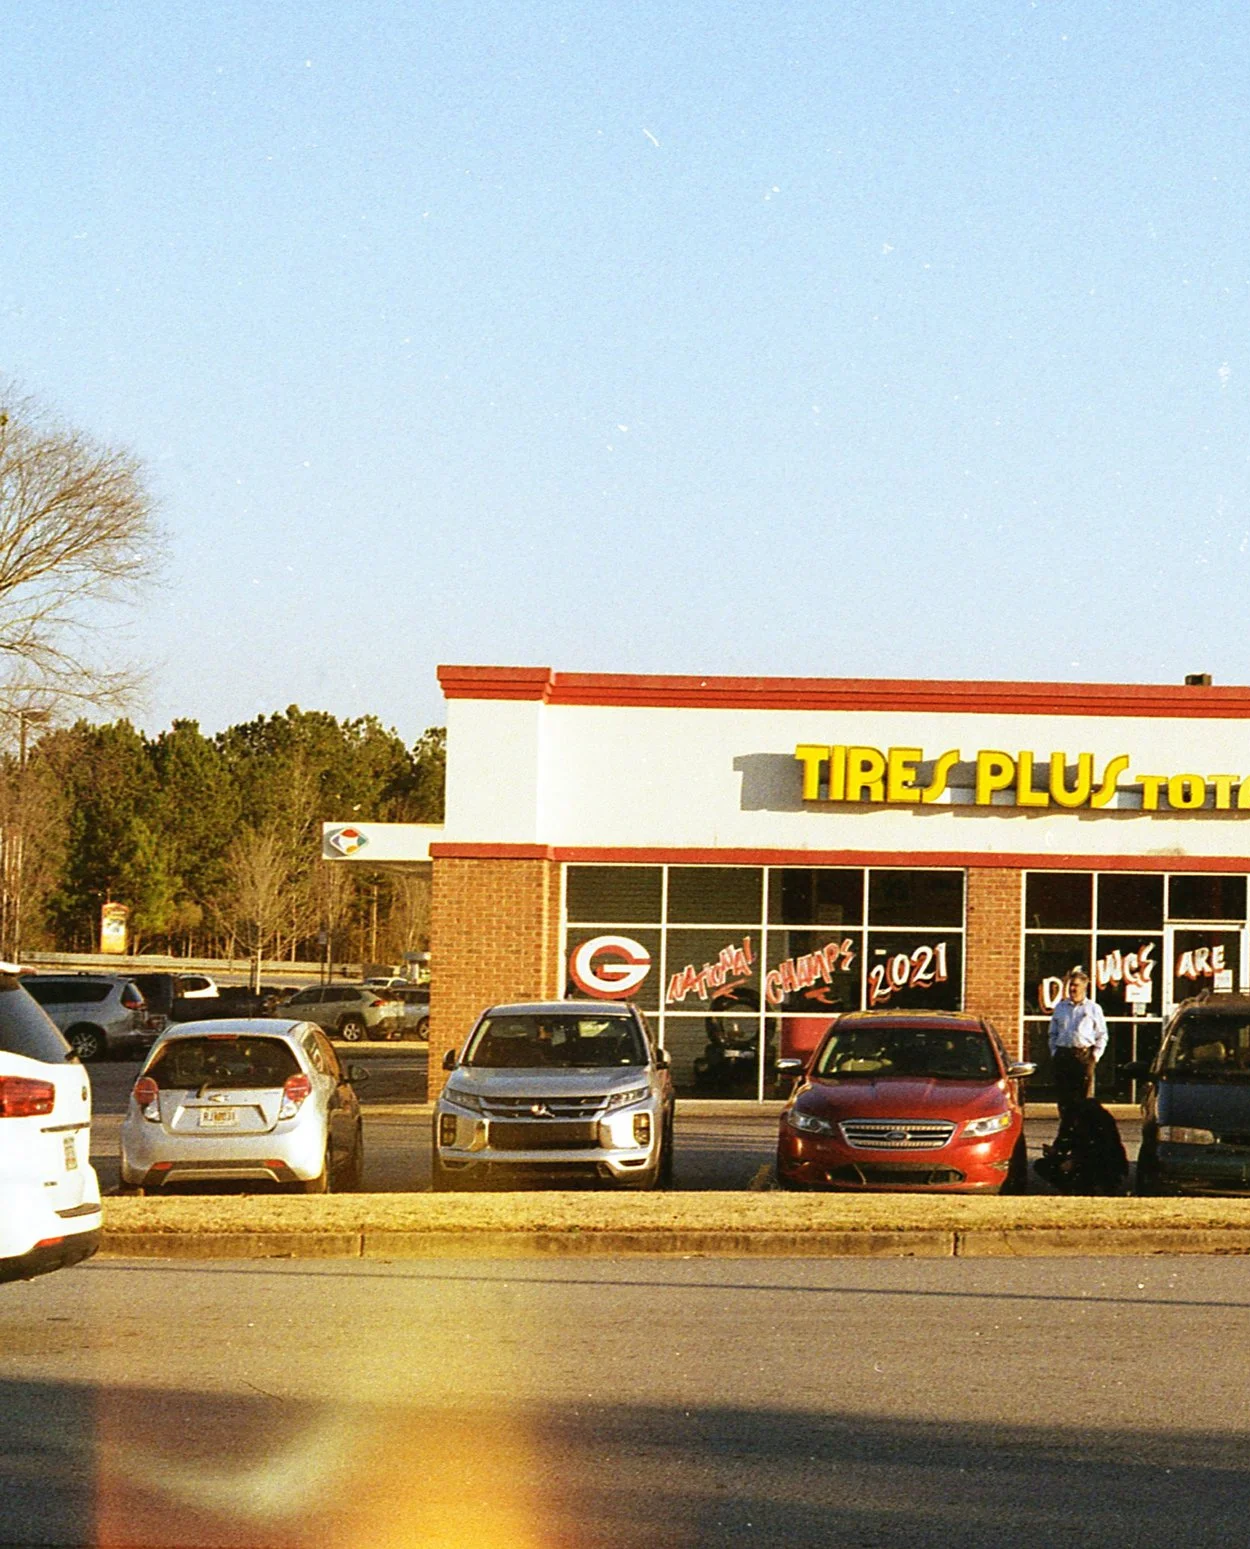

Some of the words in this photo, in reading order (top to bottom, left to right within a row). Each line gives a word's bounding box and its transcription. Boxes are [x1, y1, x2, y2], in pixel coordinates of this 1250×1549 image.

[795, 744, 960, 804] TIRES
[976, 750, 1129, 809] PLUS
[570, 935, 652, 999] G
[766, 938, 856, 1005] CHAMPS
[868, 942, 948, 1004] 2021
[1177, 944, 1226, 981] ARE
